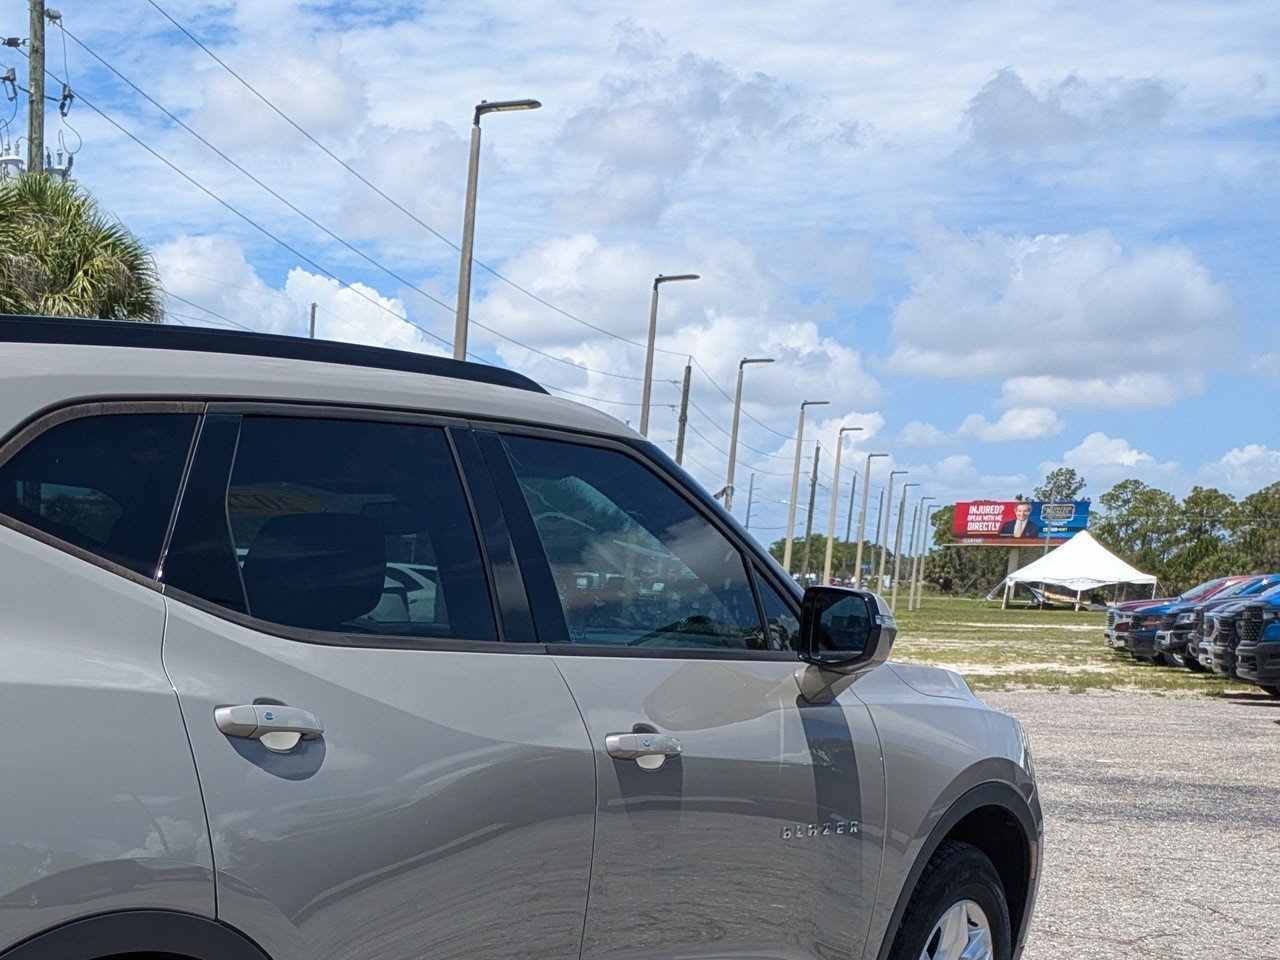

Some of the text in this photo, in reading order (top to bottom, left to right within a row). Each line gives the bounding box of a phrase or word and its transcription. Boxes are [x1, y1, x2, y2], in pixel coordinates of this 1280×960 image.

[969, 504, 1005, 515] INJURED?
[967, 514, 982, 522] SPEAK
[967, 522, 1001, 531] DIRECTLY
[781, 820, 859, 839] BLAZER
